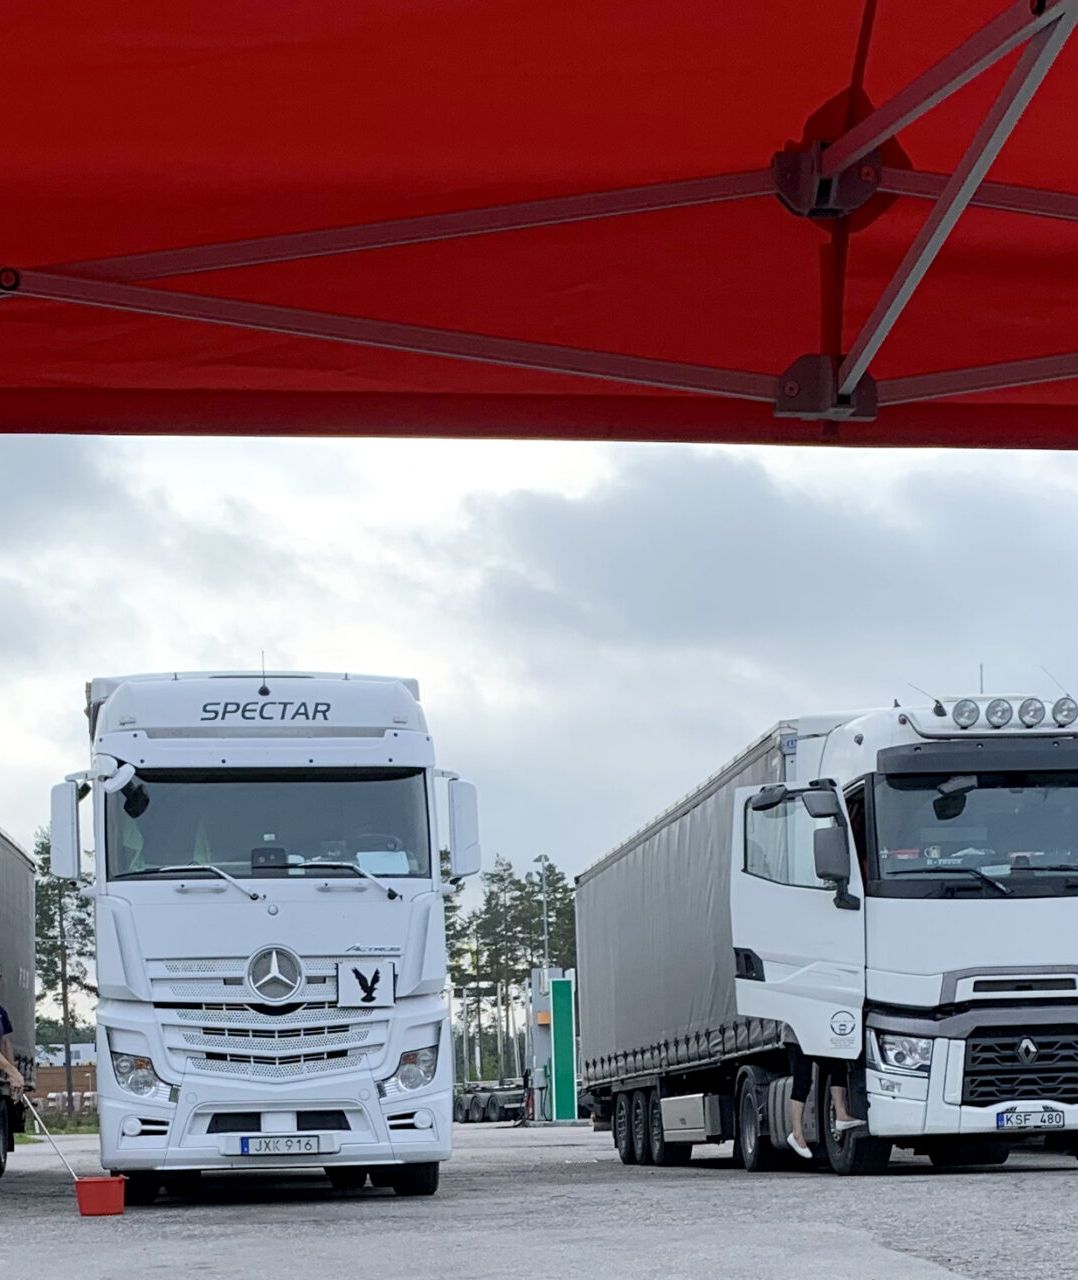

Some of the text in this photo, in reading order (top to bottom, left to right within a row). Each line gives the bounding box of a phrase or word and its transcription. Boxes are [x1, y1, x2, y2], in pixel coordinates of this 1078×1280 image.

[200, 701, 332, 721] SPECTAR
[1005, 1112, 1062, 1125] KSF 480
[255, 1138, 313, 1152] JXK 916
